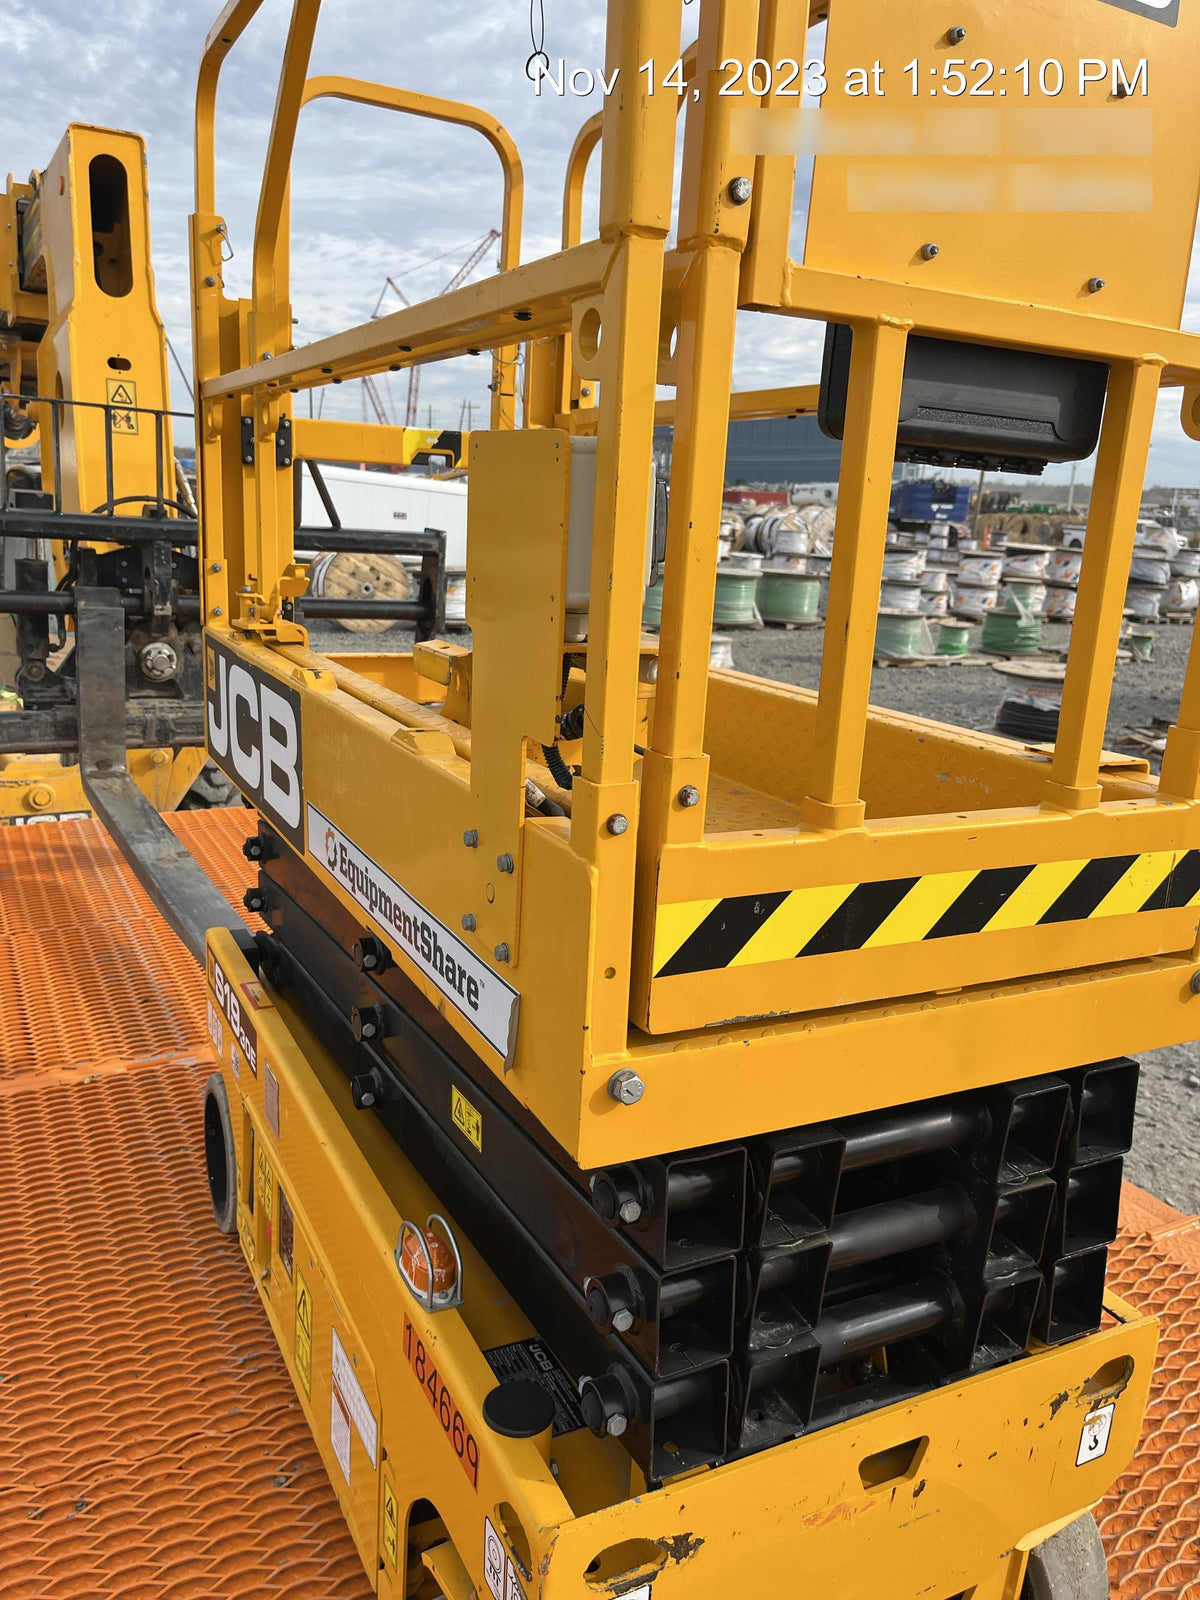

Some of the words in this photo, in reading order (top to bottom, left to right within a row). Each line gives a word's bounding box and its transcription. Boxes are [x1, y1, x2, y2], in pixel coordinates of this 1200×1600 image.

[208, 656, 300, 828] JCB
[339, 842, 479, 1012] EquipmentShare
[404, 1324, 480, 1487] 184669
[529, 1343, 553, 1371] JCB
